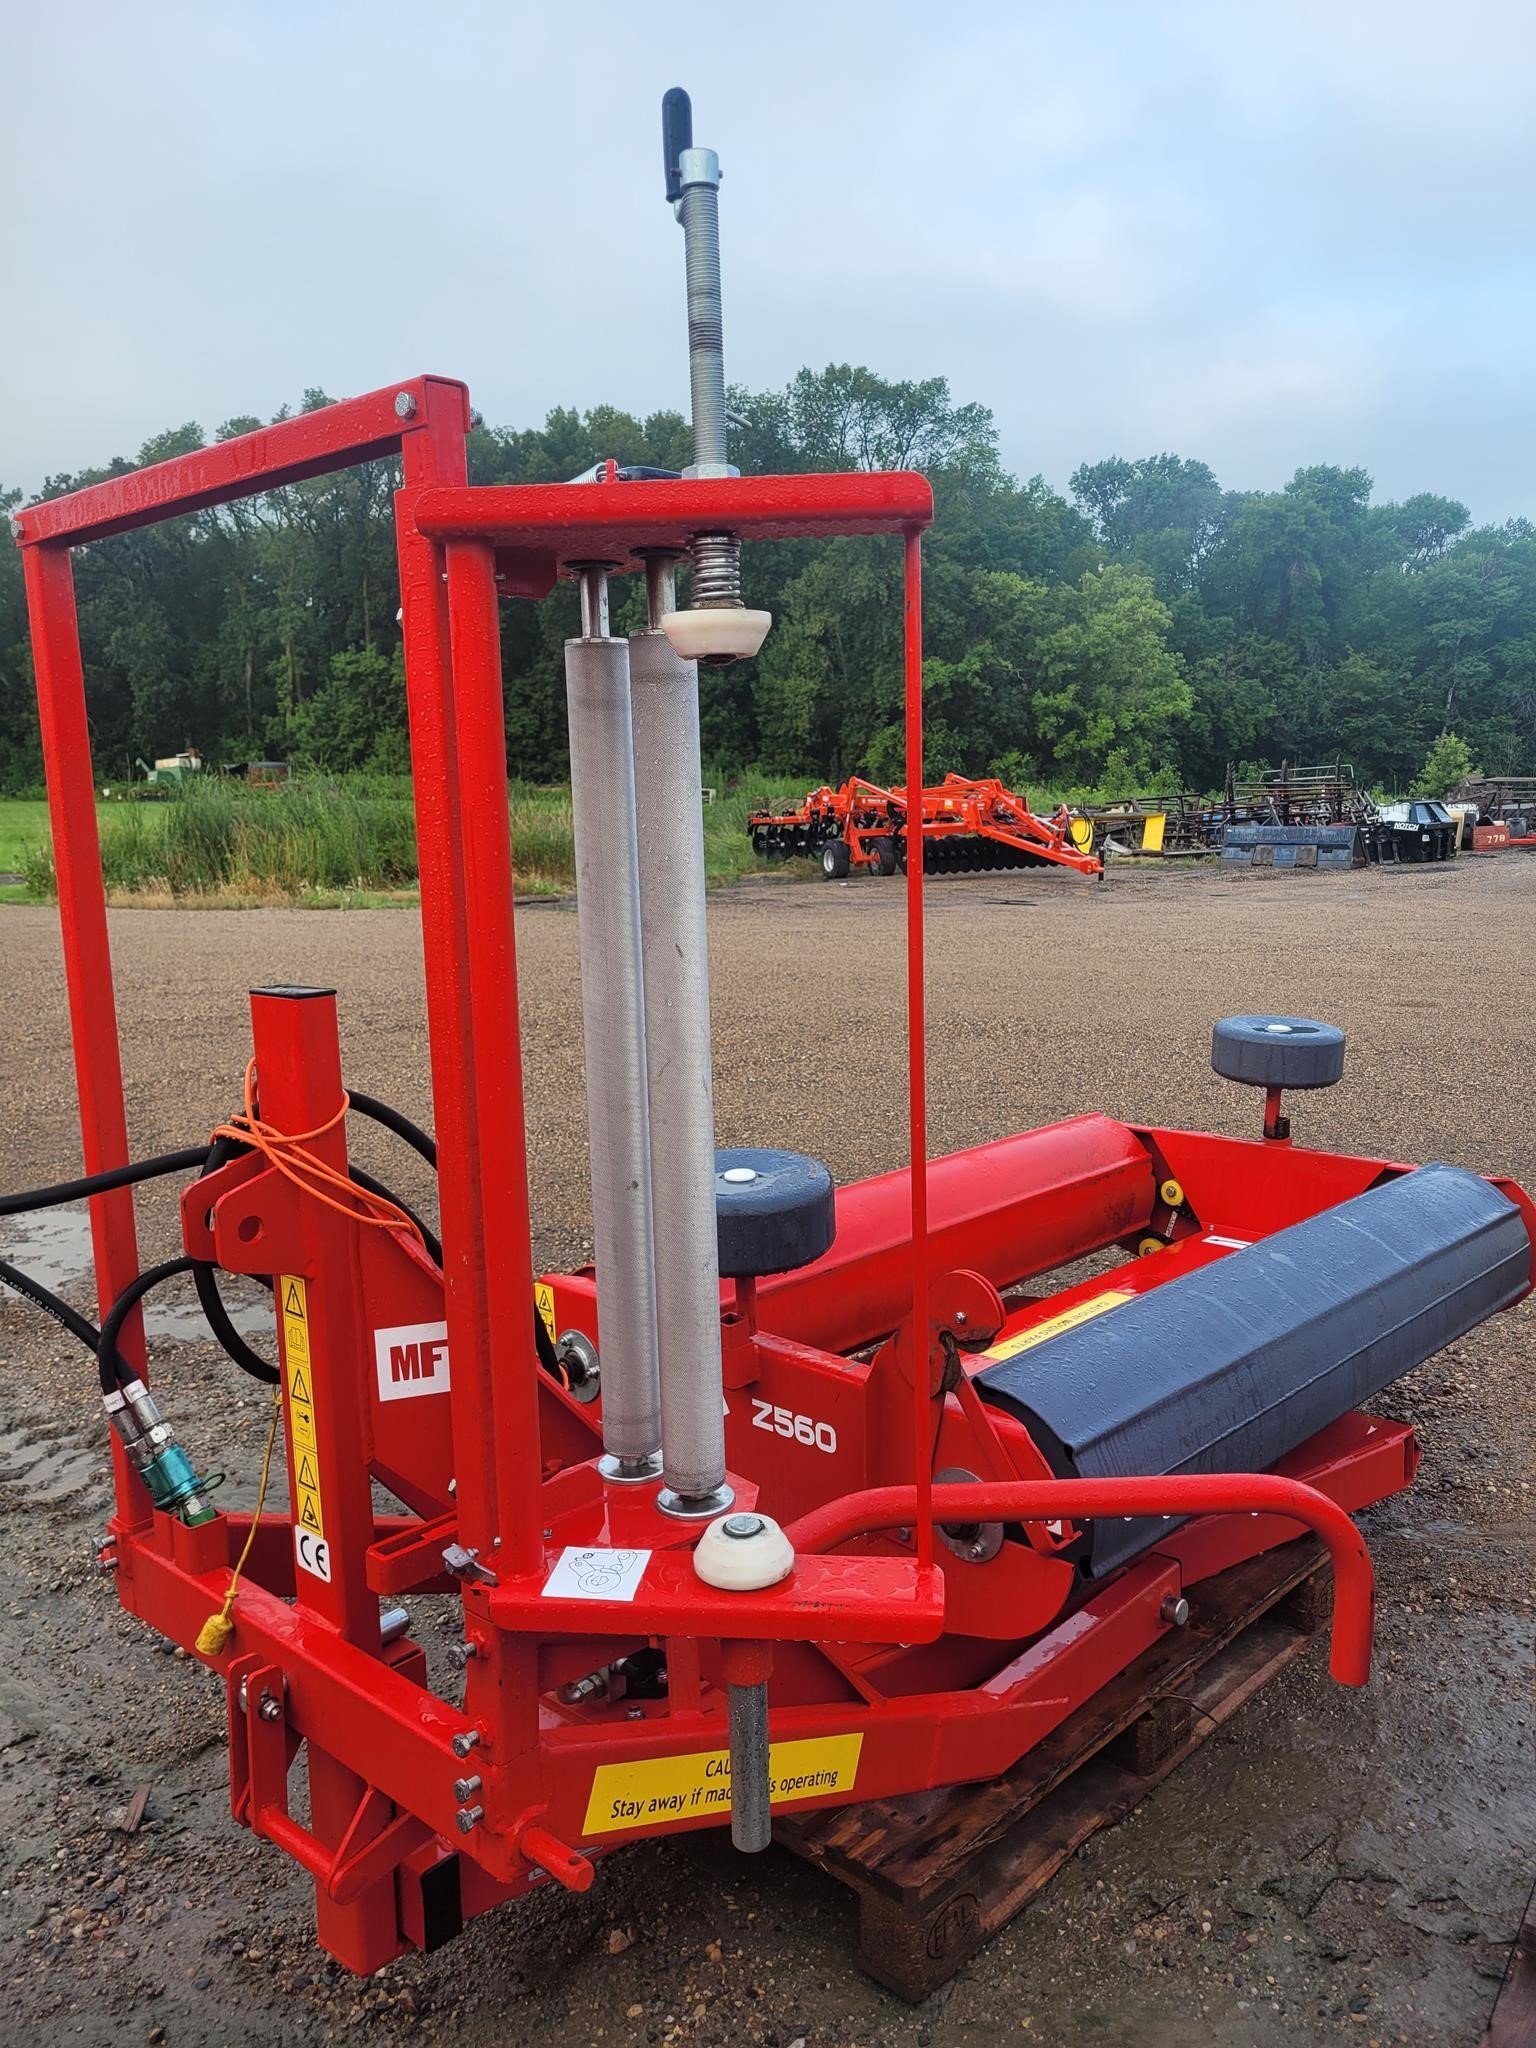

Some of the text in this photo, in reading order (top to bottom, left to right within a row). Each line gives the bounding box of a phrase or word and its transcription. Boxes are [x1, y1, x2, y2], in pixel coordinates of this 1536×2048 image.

[1393, 822, 1420, 832] NOTCH
[1486, 834, 1506, 844] 778
[389, 1339, 449, 1383] MF
[751, 1398, 837, 1454] Z560
[611, 1799, 645, 1820] Stay
[648, 1793, 687, 1813] away
[690, 1787, 704, 1806] if
[780, 1769, 838, 1794] operating
